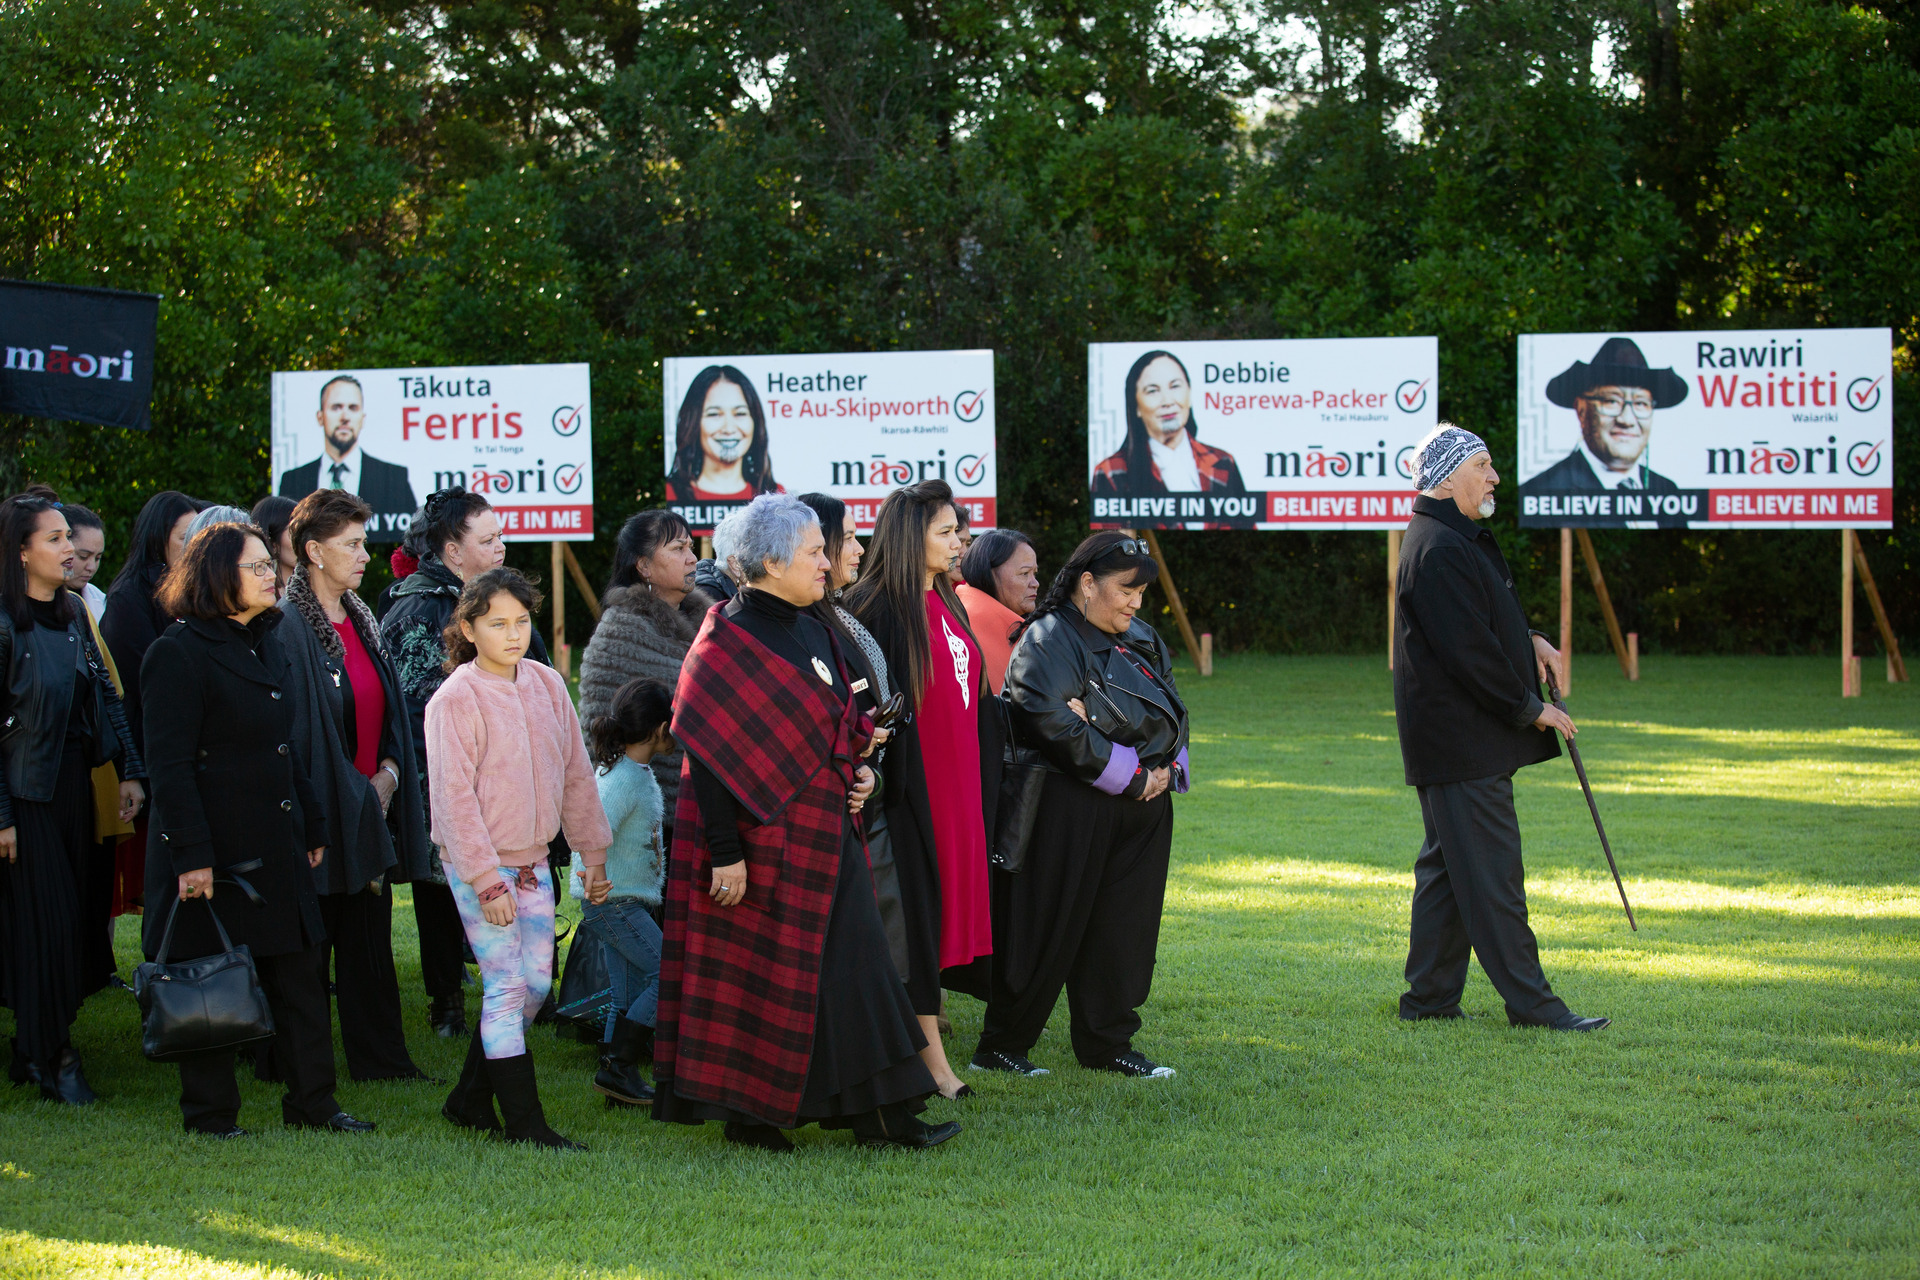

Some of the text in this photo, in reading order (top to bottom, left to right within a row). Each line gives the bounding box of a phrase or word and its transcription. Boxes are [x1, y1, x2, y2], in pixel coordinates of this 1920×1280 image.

[4, 344, 134, 382] māori
[1697, 338, 1803, 369] Rawiri
[767, 370, 868, 393] Heather
[1204, 361, 1290, 384] Debbie
[398, 374, 491, 398] Tākuta
[1697, 371, 1838, 408] Waititi
[768, 395, 949, 422] Te Au-Skipworth
[1205, 389, 1388, 415] Ngarewa-Packer
[402, 402, 523, 441] Ferris
[1321, 413, 1331, 422] Te
[1334, 413, 1347, 422] Tai
[1792, 412, 1838, 422] Waiariki
[474, 445, 524, 455] Te Tai Tonga
[1264, 440, 1387, 477] māori
[1706, 436, 1839, 475] māori
[1094, 497, 1257, 517] BELIEVE IN YOU
[1273, 496, 1417, 516] BELIEVE IN M
[1524, 495, 1698, 515] BELIEVE IN YOU
[1716, 495, 1878, 515] BELIEVE IN ME
[383, 513, 412, 531] YO
[523, 511, 547, 529] IN
[551, 510, 582, 529] ME
